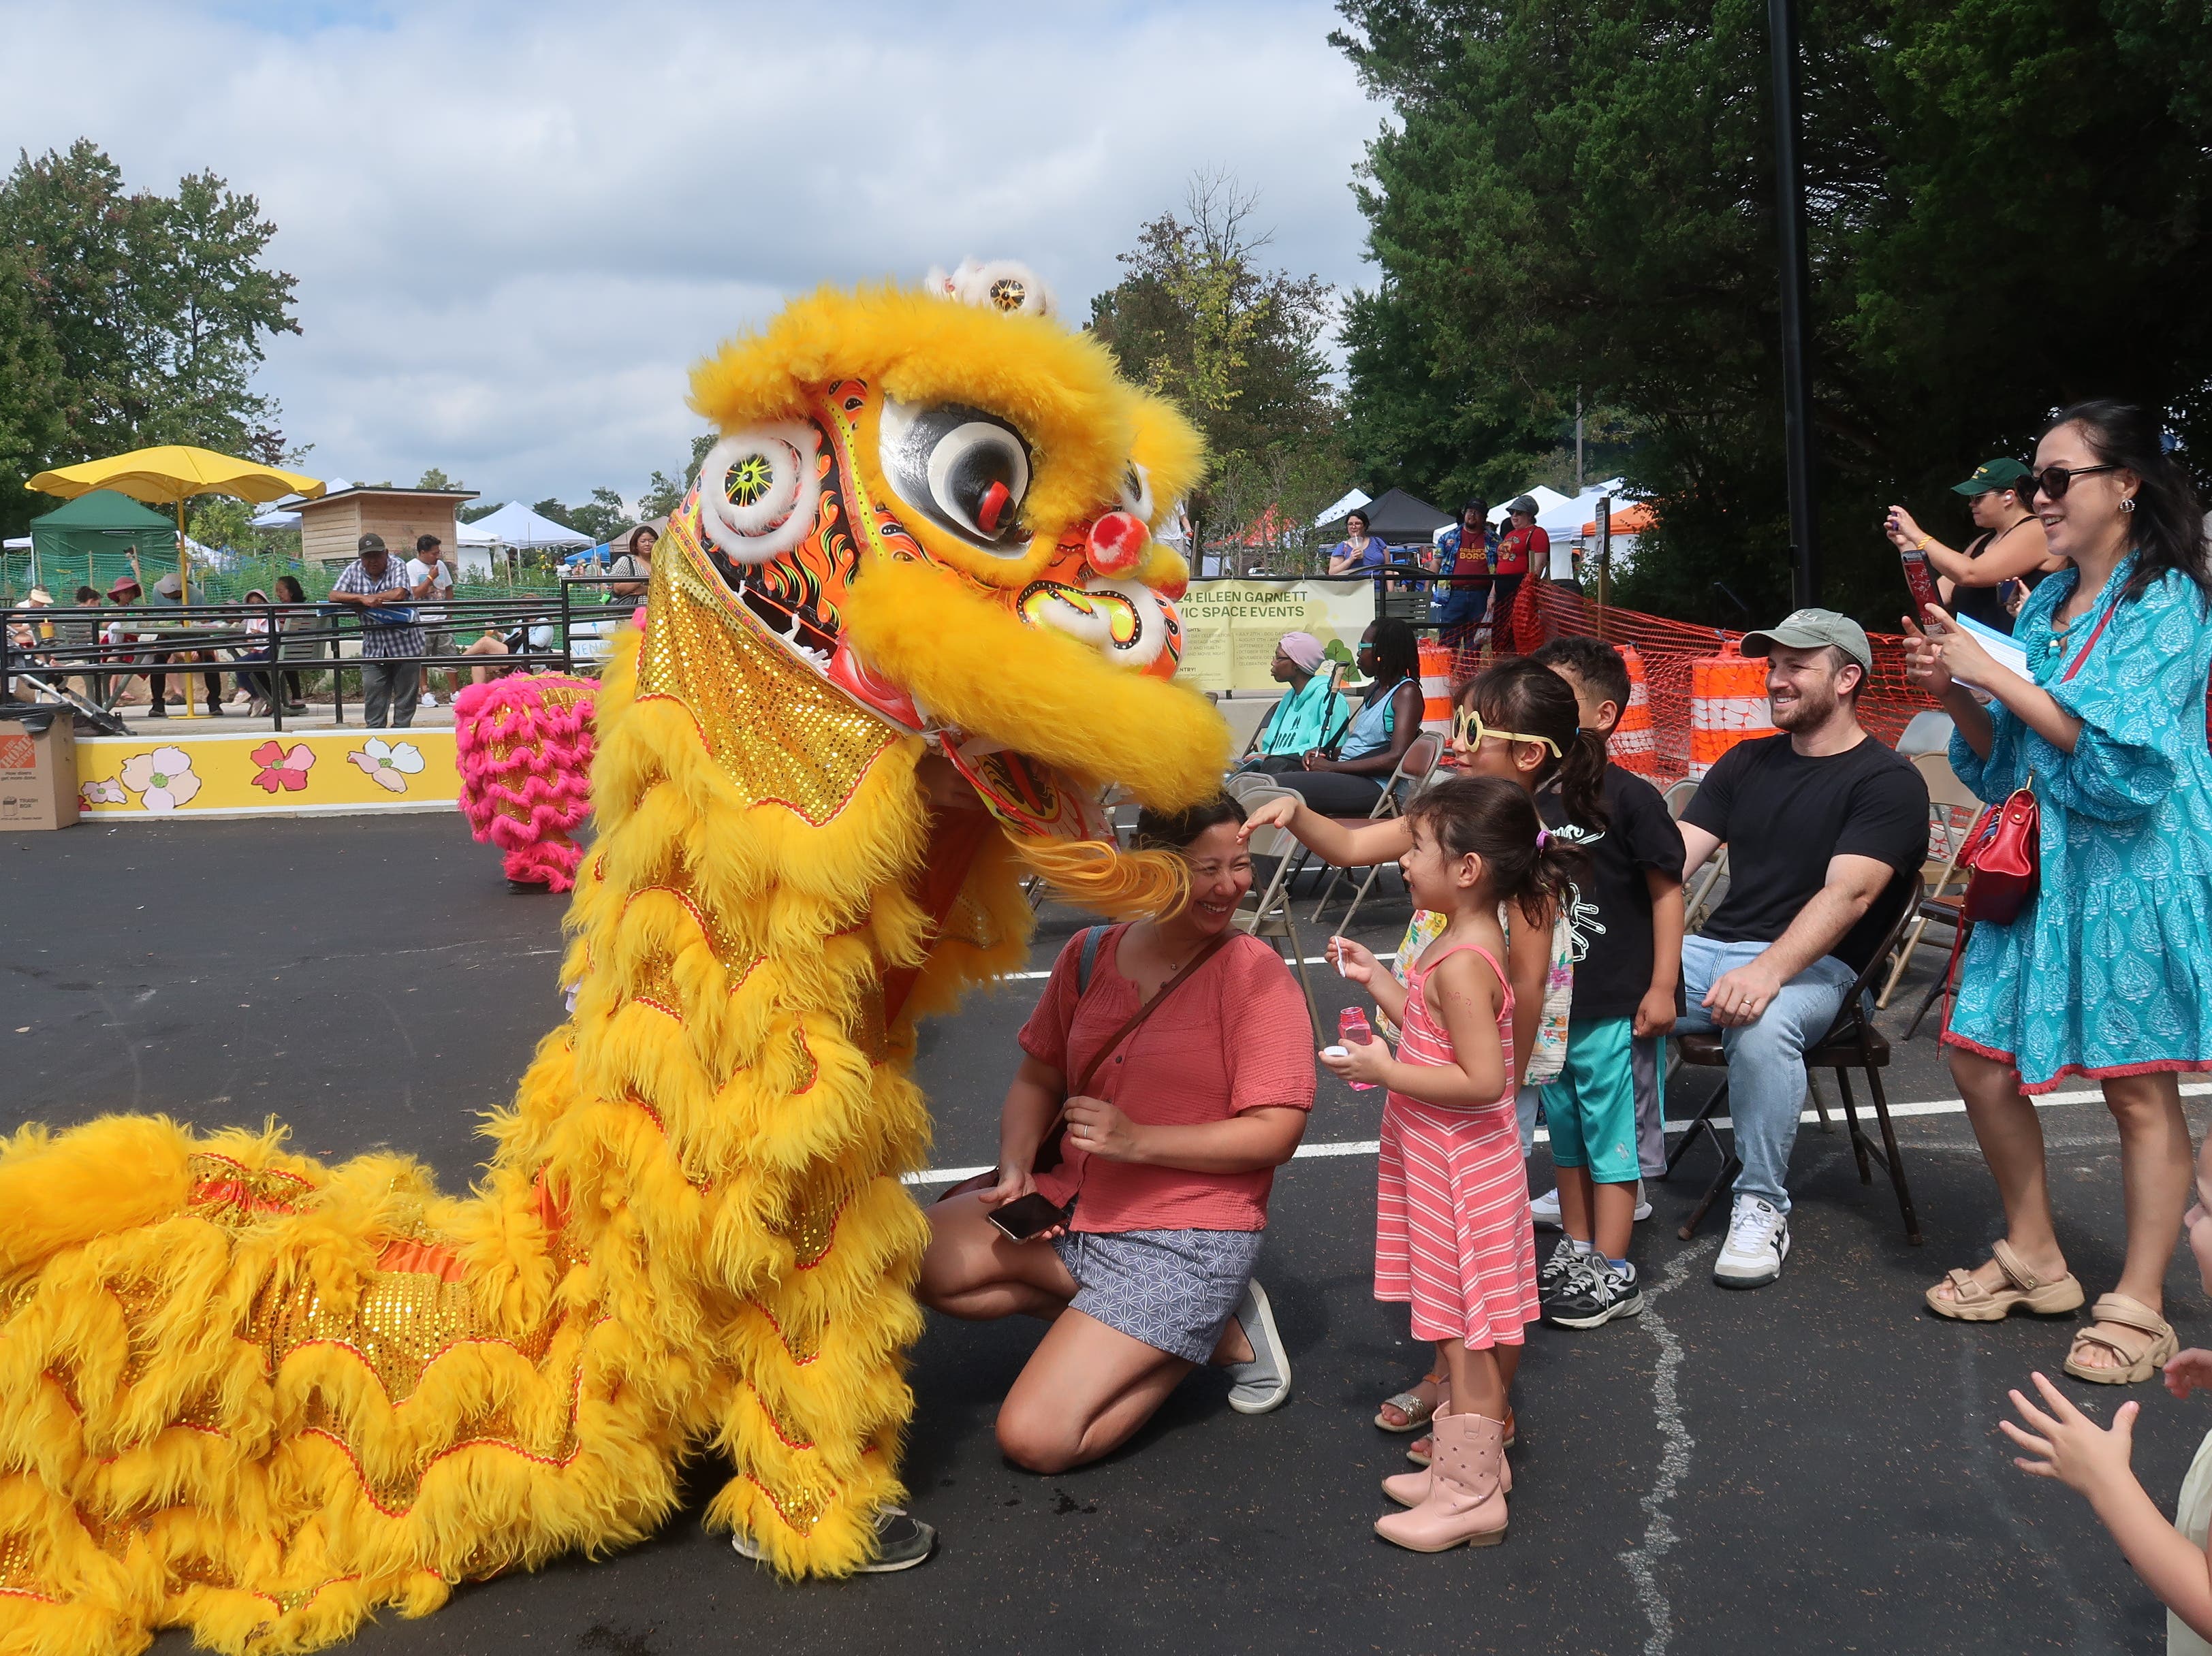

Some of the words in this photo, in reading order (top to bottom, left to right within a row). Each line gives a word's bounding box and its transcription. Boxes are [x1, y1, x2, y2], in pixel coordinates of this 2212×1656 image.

[1177, 592, 1193, 603] 4
[1196, 591, 1241, 603] EILEEN
[1244, 591, 1308, 603] GARNETT
[1202, 606, 1247, 618] SPACE
[1250, 605, 1305, 618] EVENTS
[0, 735, 34, 768] HOME
